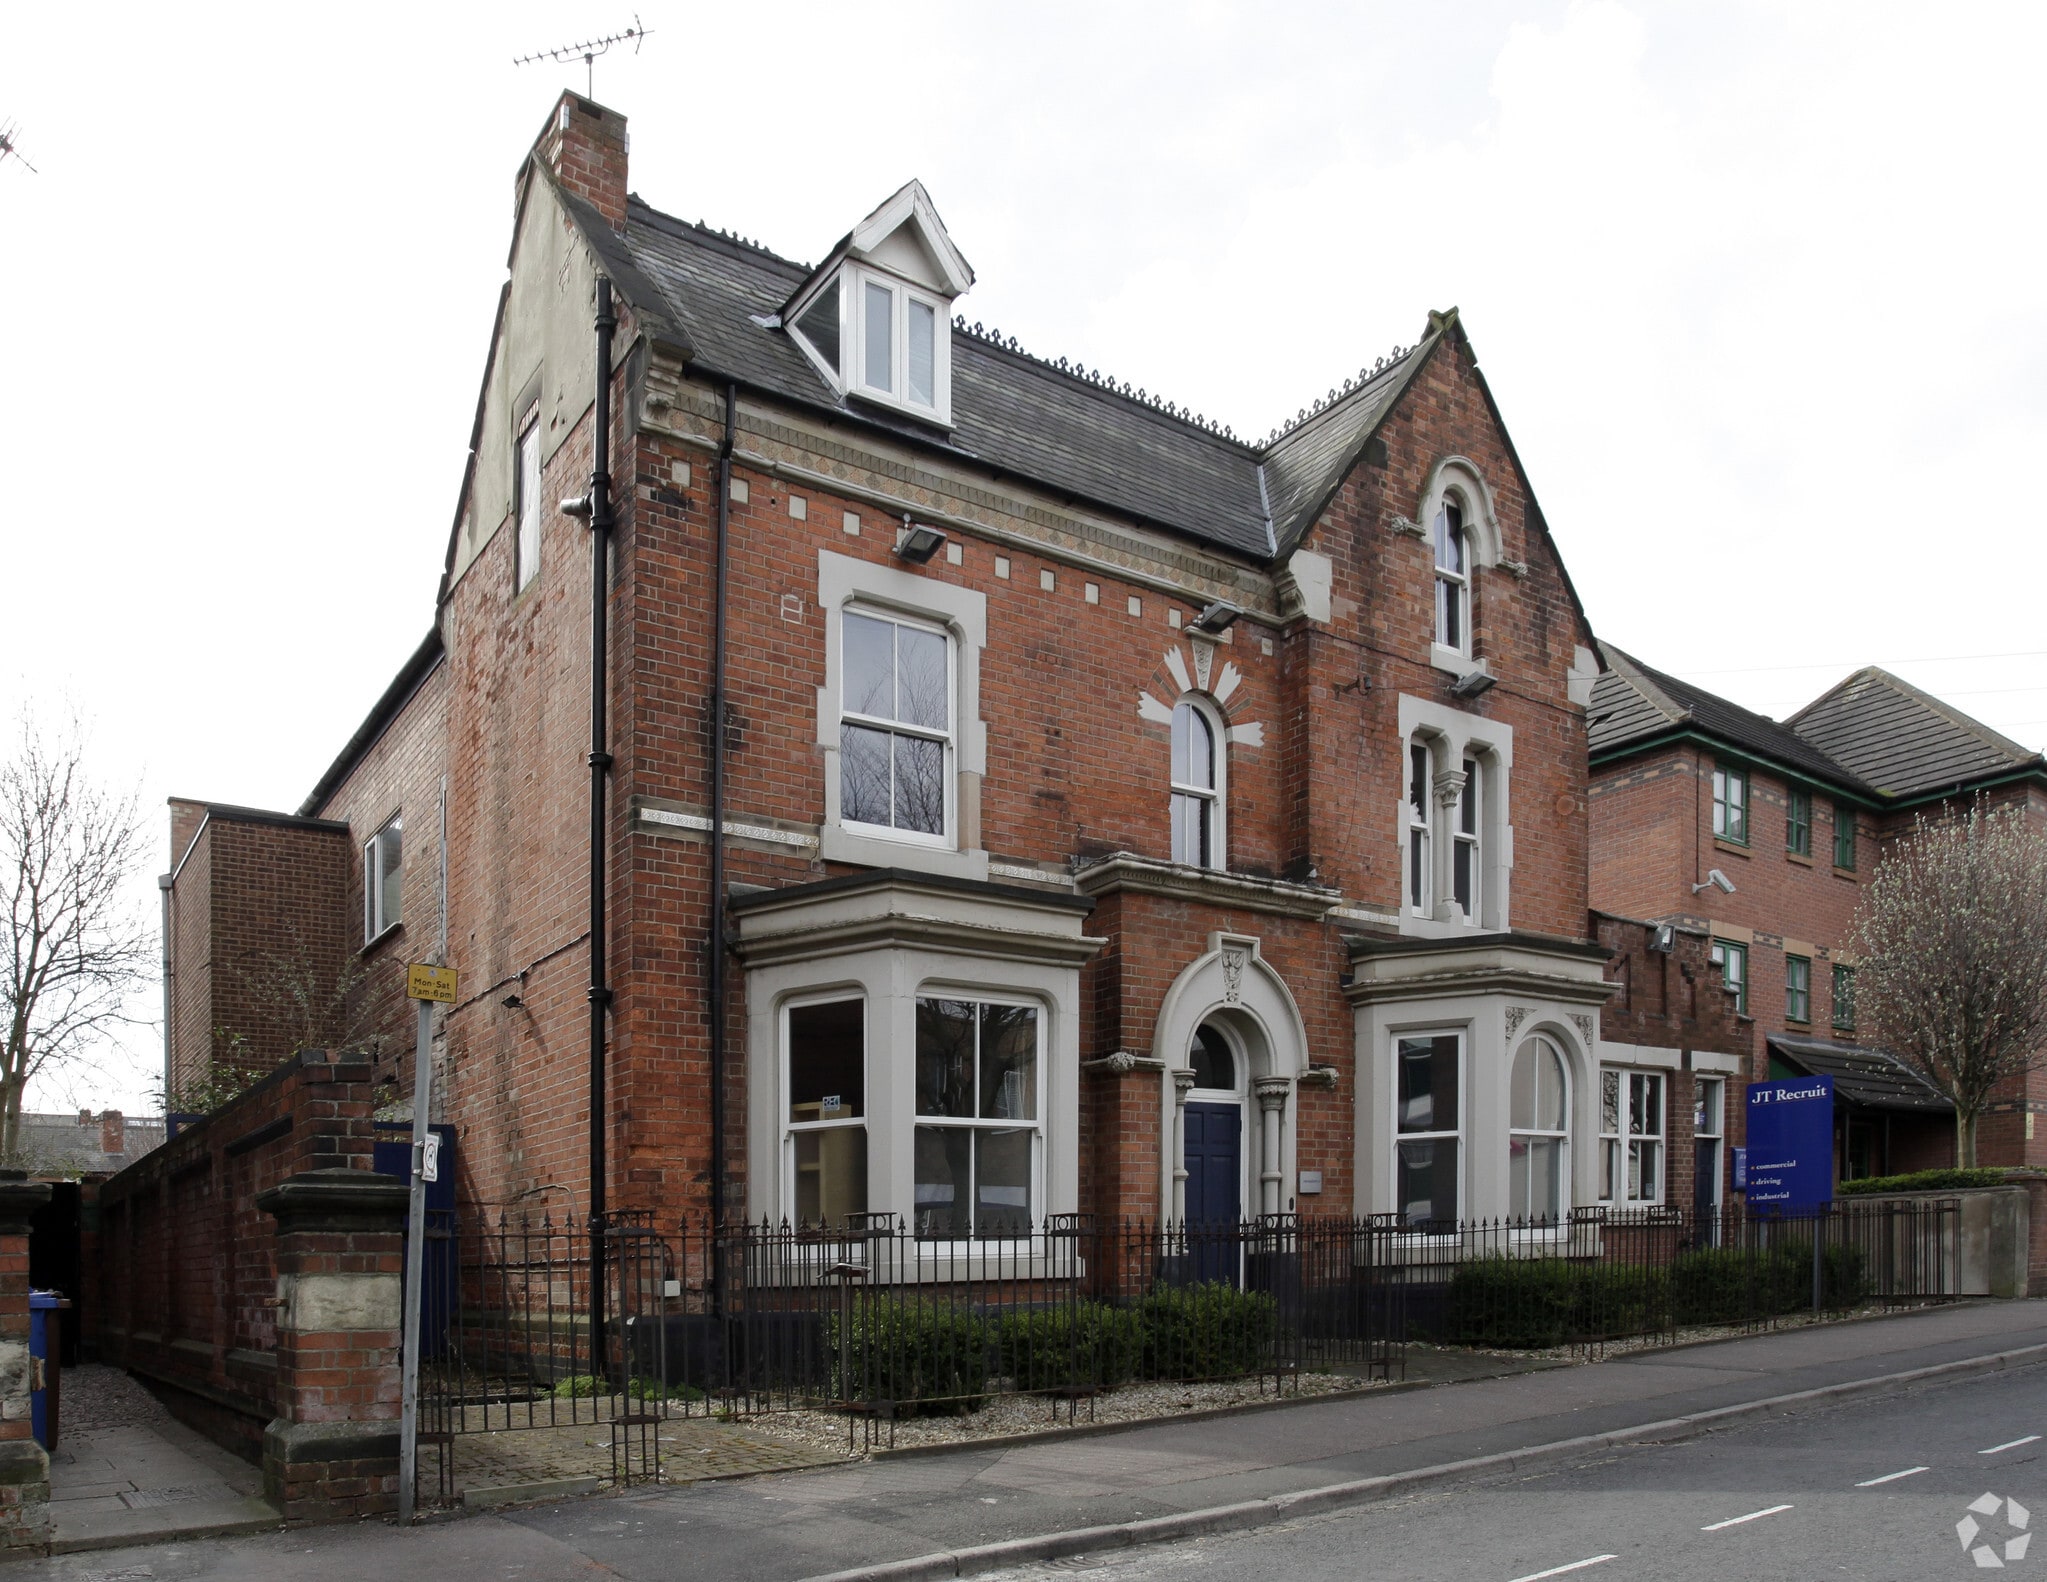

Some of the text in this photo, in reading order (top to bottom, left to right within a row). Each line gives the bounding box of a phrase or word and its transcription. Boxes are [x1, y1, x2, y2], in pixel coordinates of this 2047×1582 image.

[1752, 1085, 1827, 1104] JT Recruit
[1756, 1160, 1796, 1170] commercial
[1756, 1177, 1782, 1186] driving
[1756, 1191, 1789, 1201] industrial
